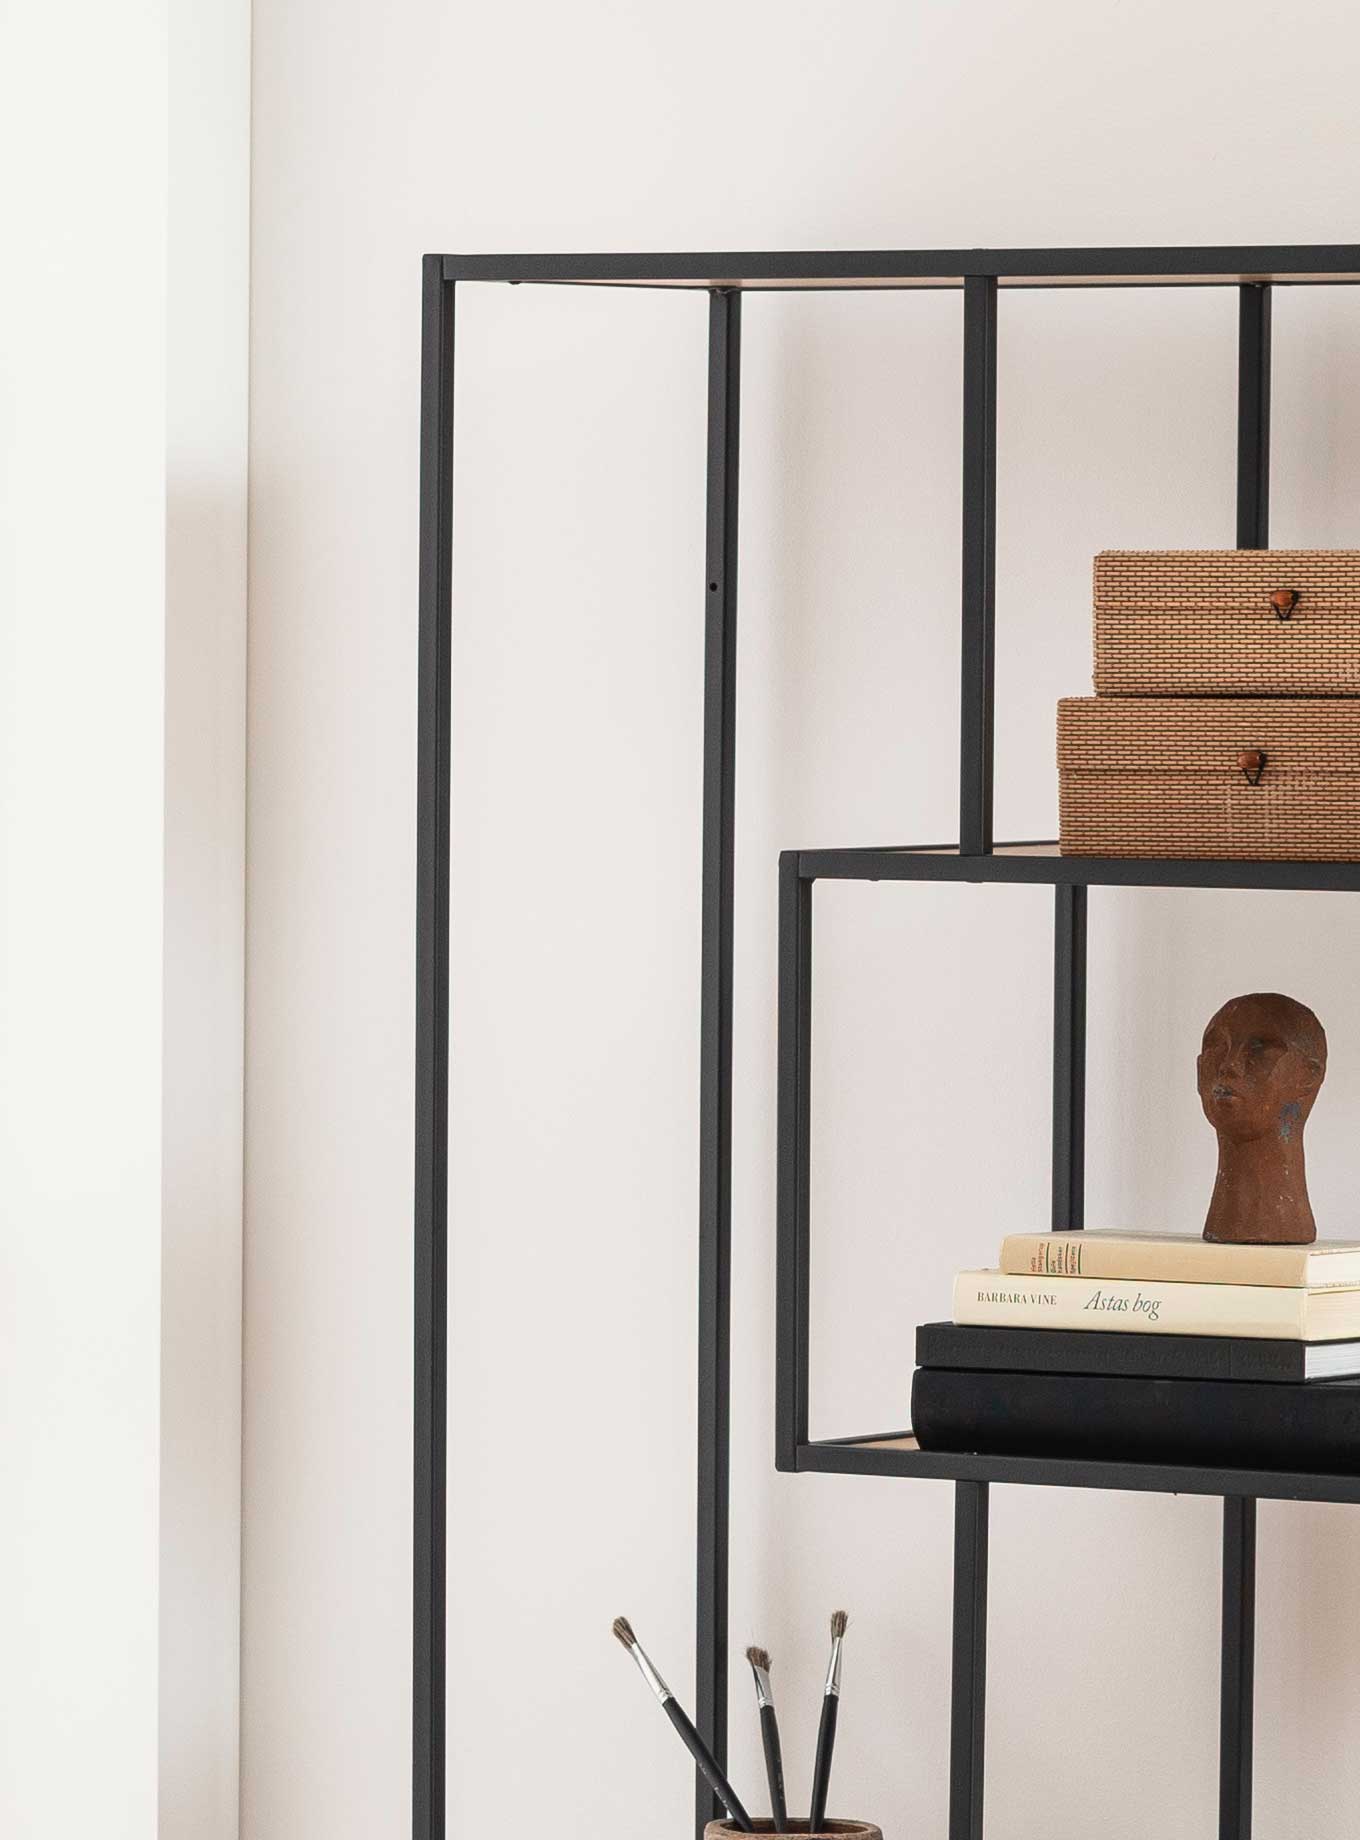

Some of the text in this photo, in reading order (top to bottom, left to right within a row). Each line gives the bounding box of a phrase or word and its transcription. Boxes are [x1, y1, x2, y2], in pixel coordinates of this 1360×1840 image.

[977, 1291, 1057, 1305] BARBARA VINE
[1084, 1290, 1162, 1320] Astas bog
